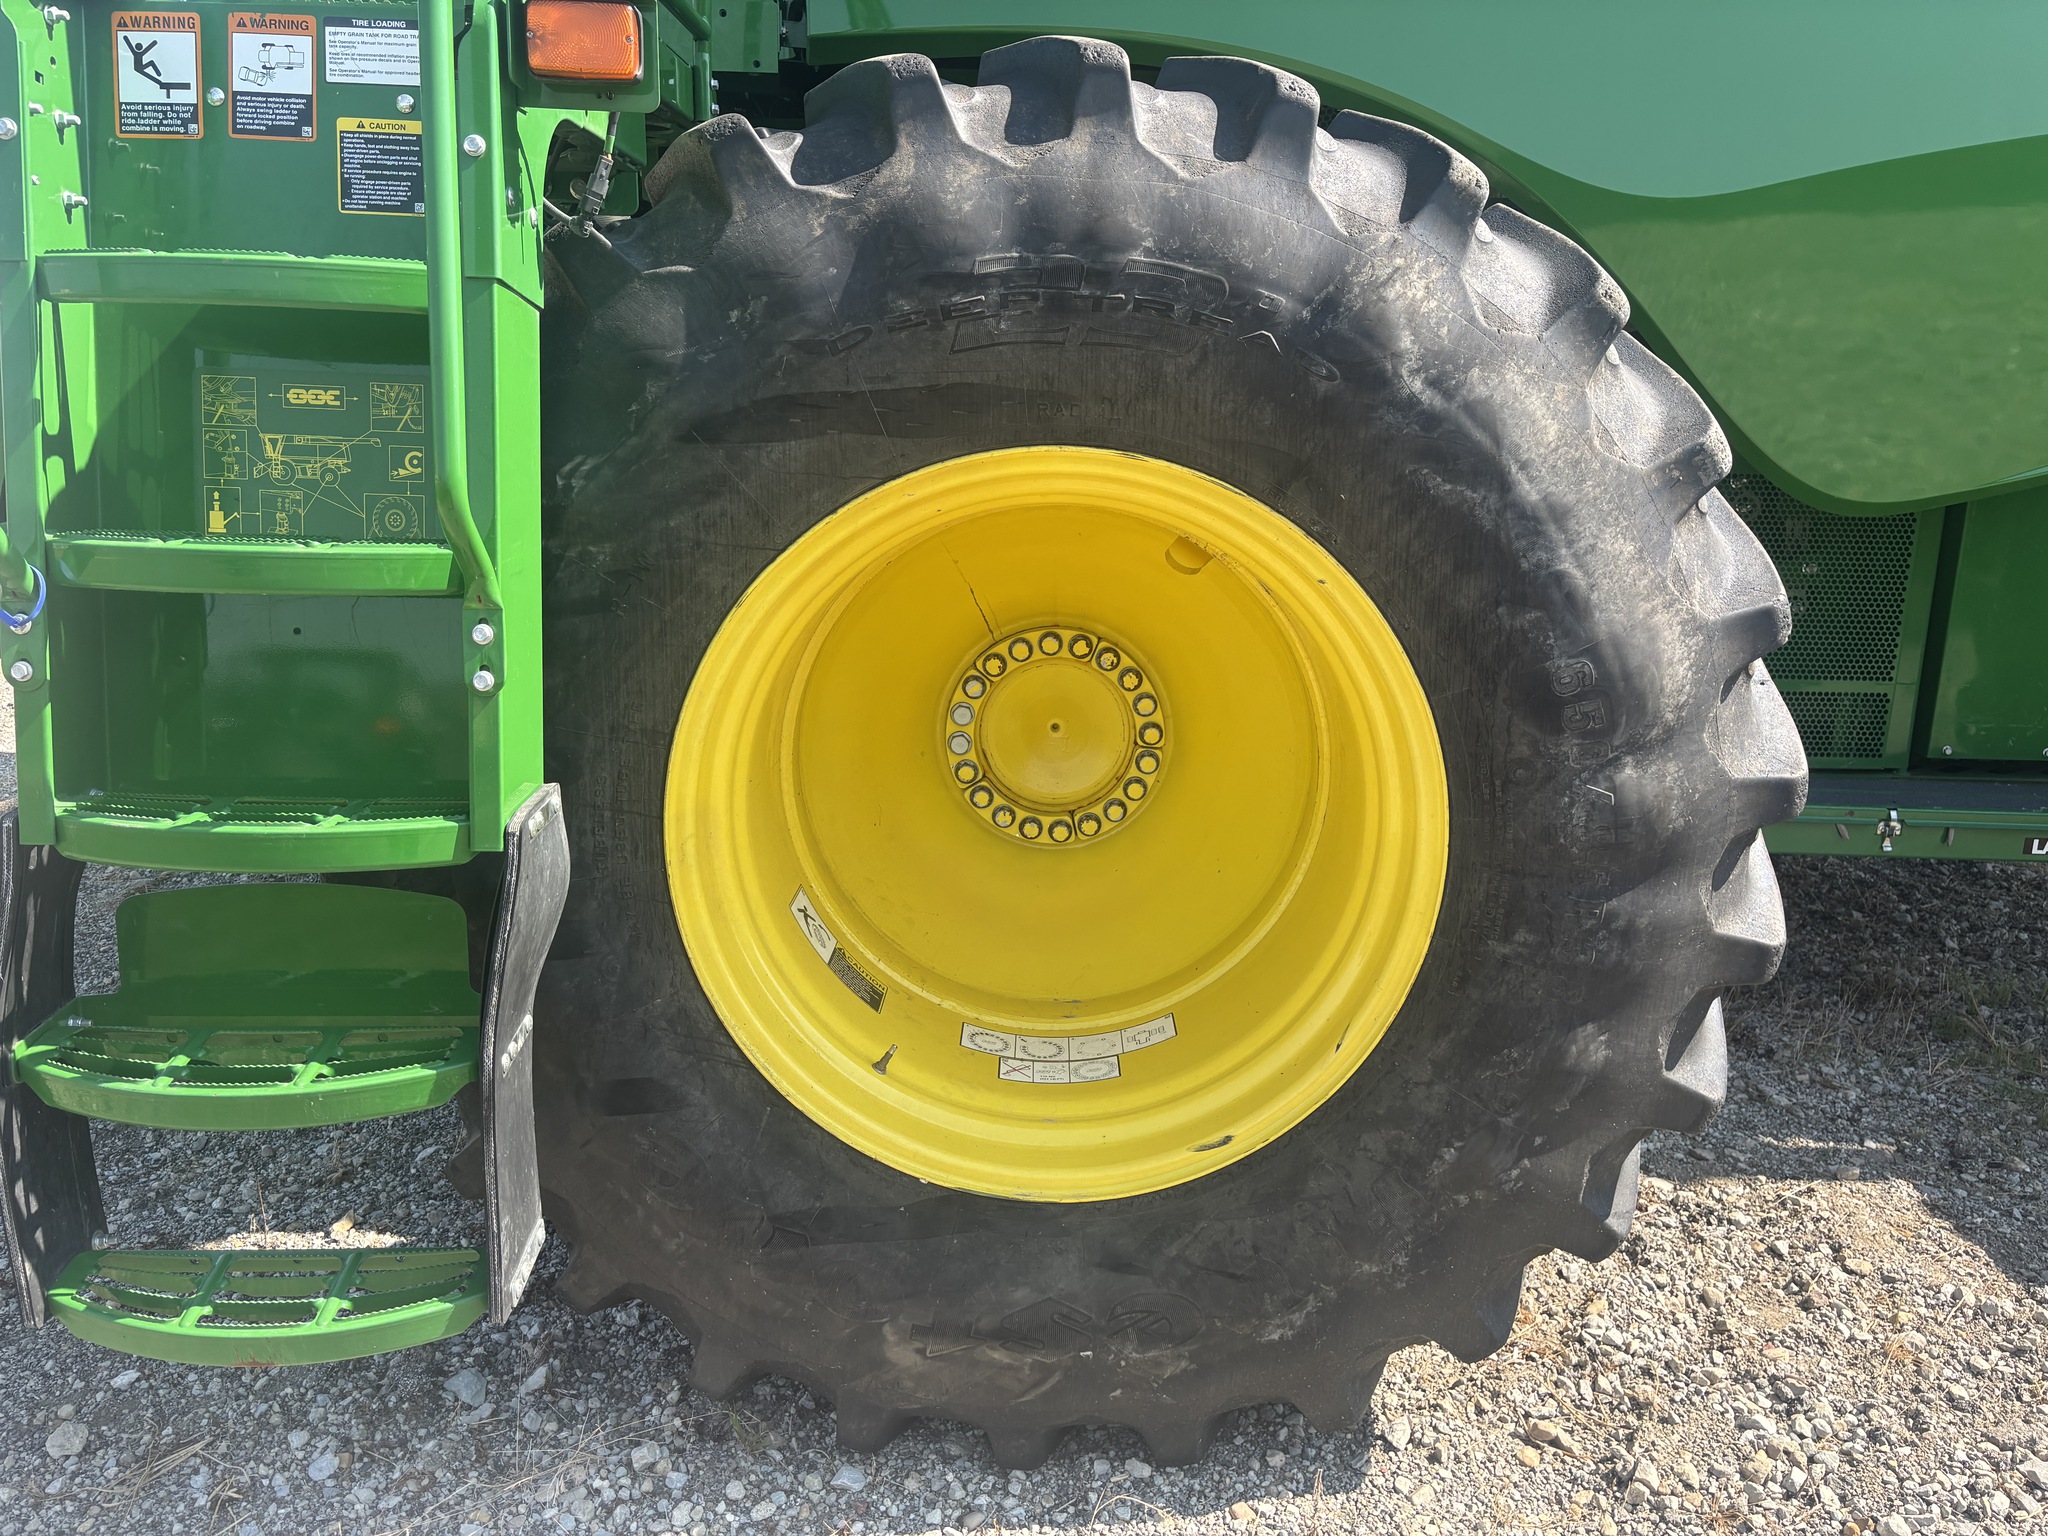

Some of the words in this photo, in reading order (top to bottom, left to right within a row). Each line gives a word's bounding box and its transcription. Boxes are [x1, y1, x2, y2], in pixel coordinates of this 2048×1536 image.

[130, 16, 196, 29] WARNING
[250, 16, 309, 30] WARNING
[370, 122, 406, 130] CAUTION
[847, 956, 886, 992] CAUTION
